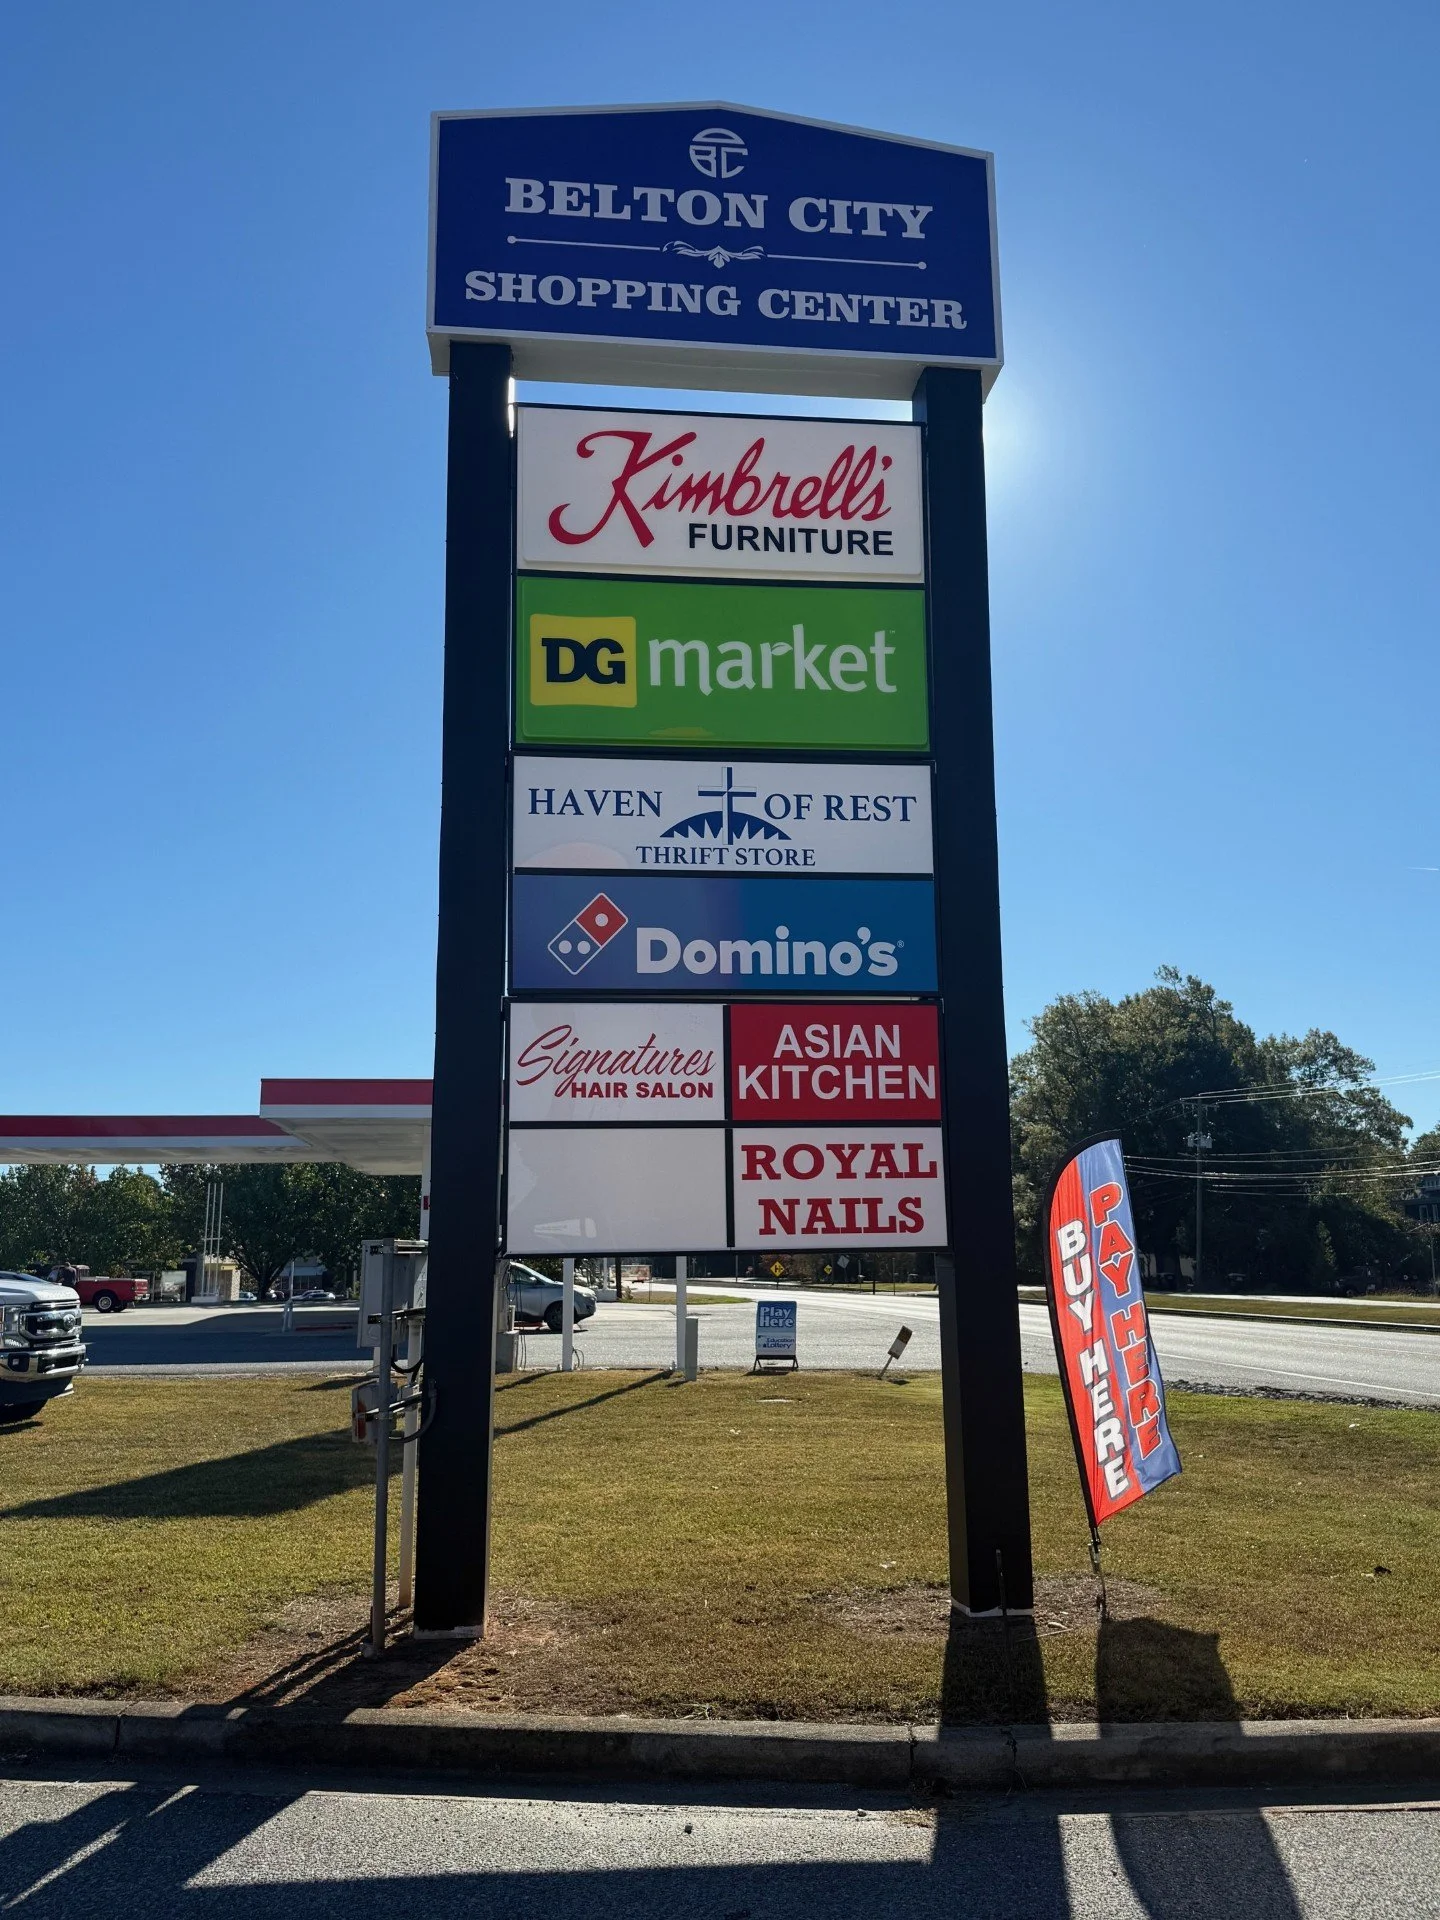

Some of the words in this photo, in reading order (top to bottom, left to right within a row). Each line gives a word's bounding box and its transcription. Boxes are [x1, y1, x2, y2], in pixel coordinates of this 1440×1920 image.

[504, 177, 769, 229] BELTON
[788, 196, 933, 240] CITY
[464, 270, 741, 318] SHOPPING
[757, 287, 968, 331] CENTER
[548, 430, 893, 548] Kimbrell's
[688, 523, 894, 556] FURNITURE
[541, 637, 627, 685] DG
[648, 623, 898, 696] market
[528, 787, 663, 818] HAVEN
[763, 793, 813, 821] OF
[823, 795, 917, 823] REST
[635, 845, 730, 866] THRIFT
[735, 848, 816, 867] STORE
[636, 925, 899, 977] Domino's
[516, 1024, 717, 1098] Signatures
[773, 1024, 901, 1059] ASIAN
[571, 1081, 629, 1099] HAIR
[635, 1081, 714, 1099] SALON
[738, 1064, 937, 1100] KITCHEN
[741, 1143, 938, 1181] ROYAL
[758, 1196, 925, 1236] NAILS
[1089, 1182, 1133, 1299] PAY
[759, 1315, 794, 1327] Here
[760, 1306, 791, 1318] Play
[1056, 1218, 1096, 1334] BUY
[1079, 1347, 1130, 1500] HERE
[1110, 1303, 1162, 1461] HERE
